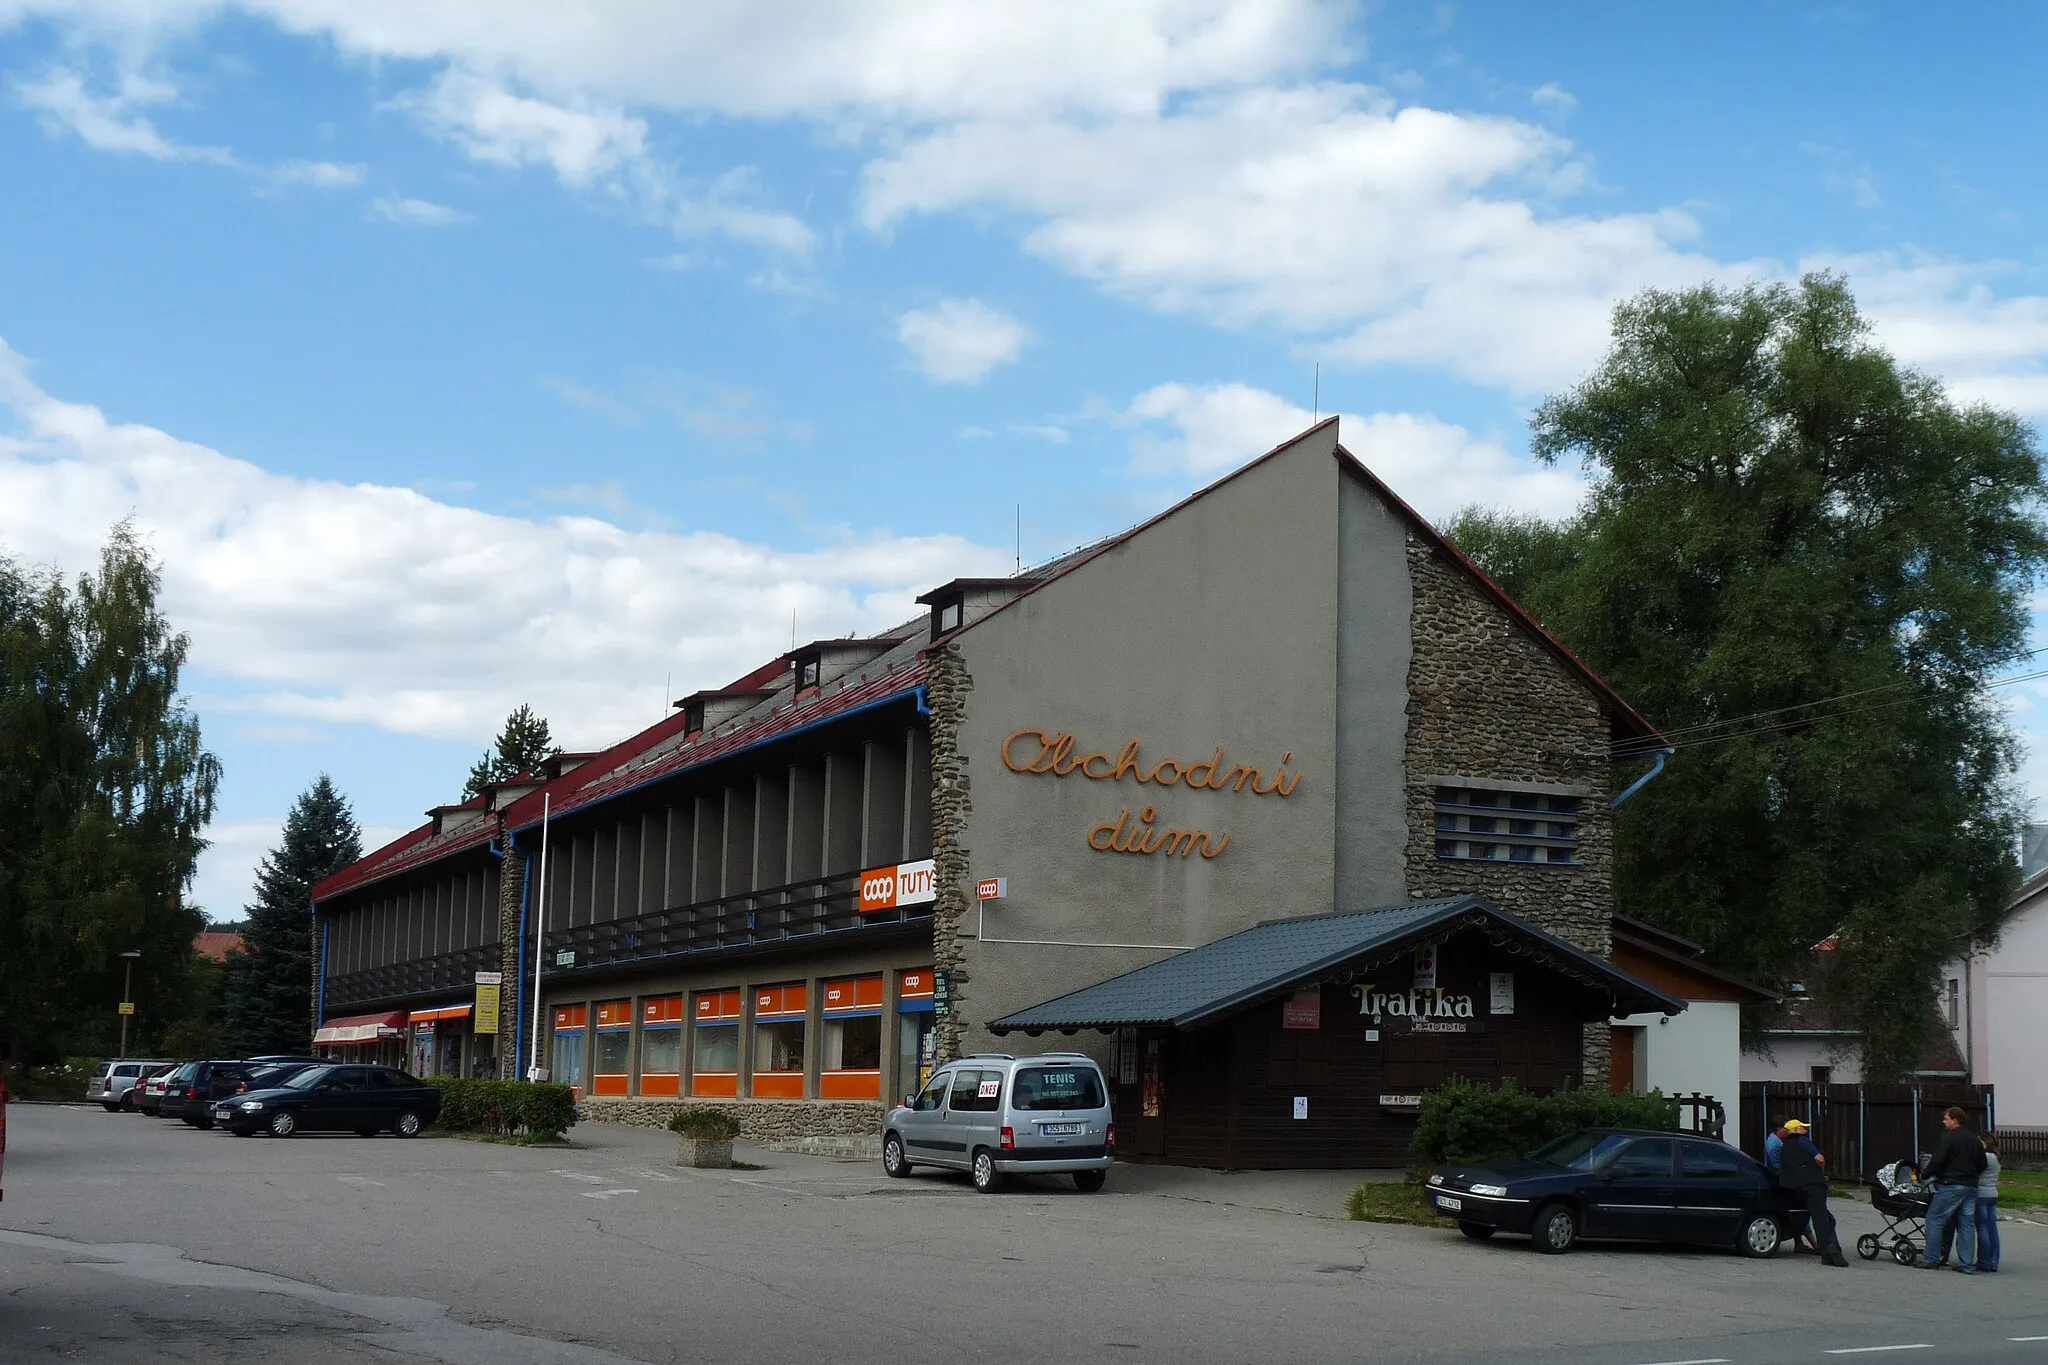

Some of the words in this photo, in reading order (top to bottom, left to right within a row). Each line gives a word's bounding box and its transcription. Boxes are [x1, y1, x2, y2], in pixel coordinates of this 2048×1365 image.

[1002, 728, 1301, 796] Obchodní
[1087, 805, 1231, 859] dům
[863, 876, 894, 903] coop
[900, 869, 935, 896] TUTY
[979, 882, 997, 897] coop
[905, 975, 920, 988] coop
[759, 995, 771, 1007] coop
[828, 989, 841, 1002] coop
[1351, 984, 1474, 1018] Trafika
[1043, 1073, 1076, 1084] TENIS
[980, 1083, 997, 1096] DNES
